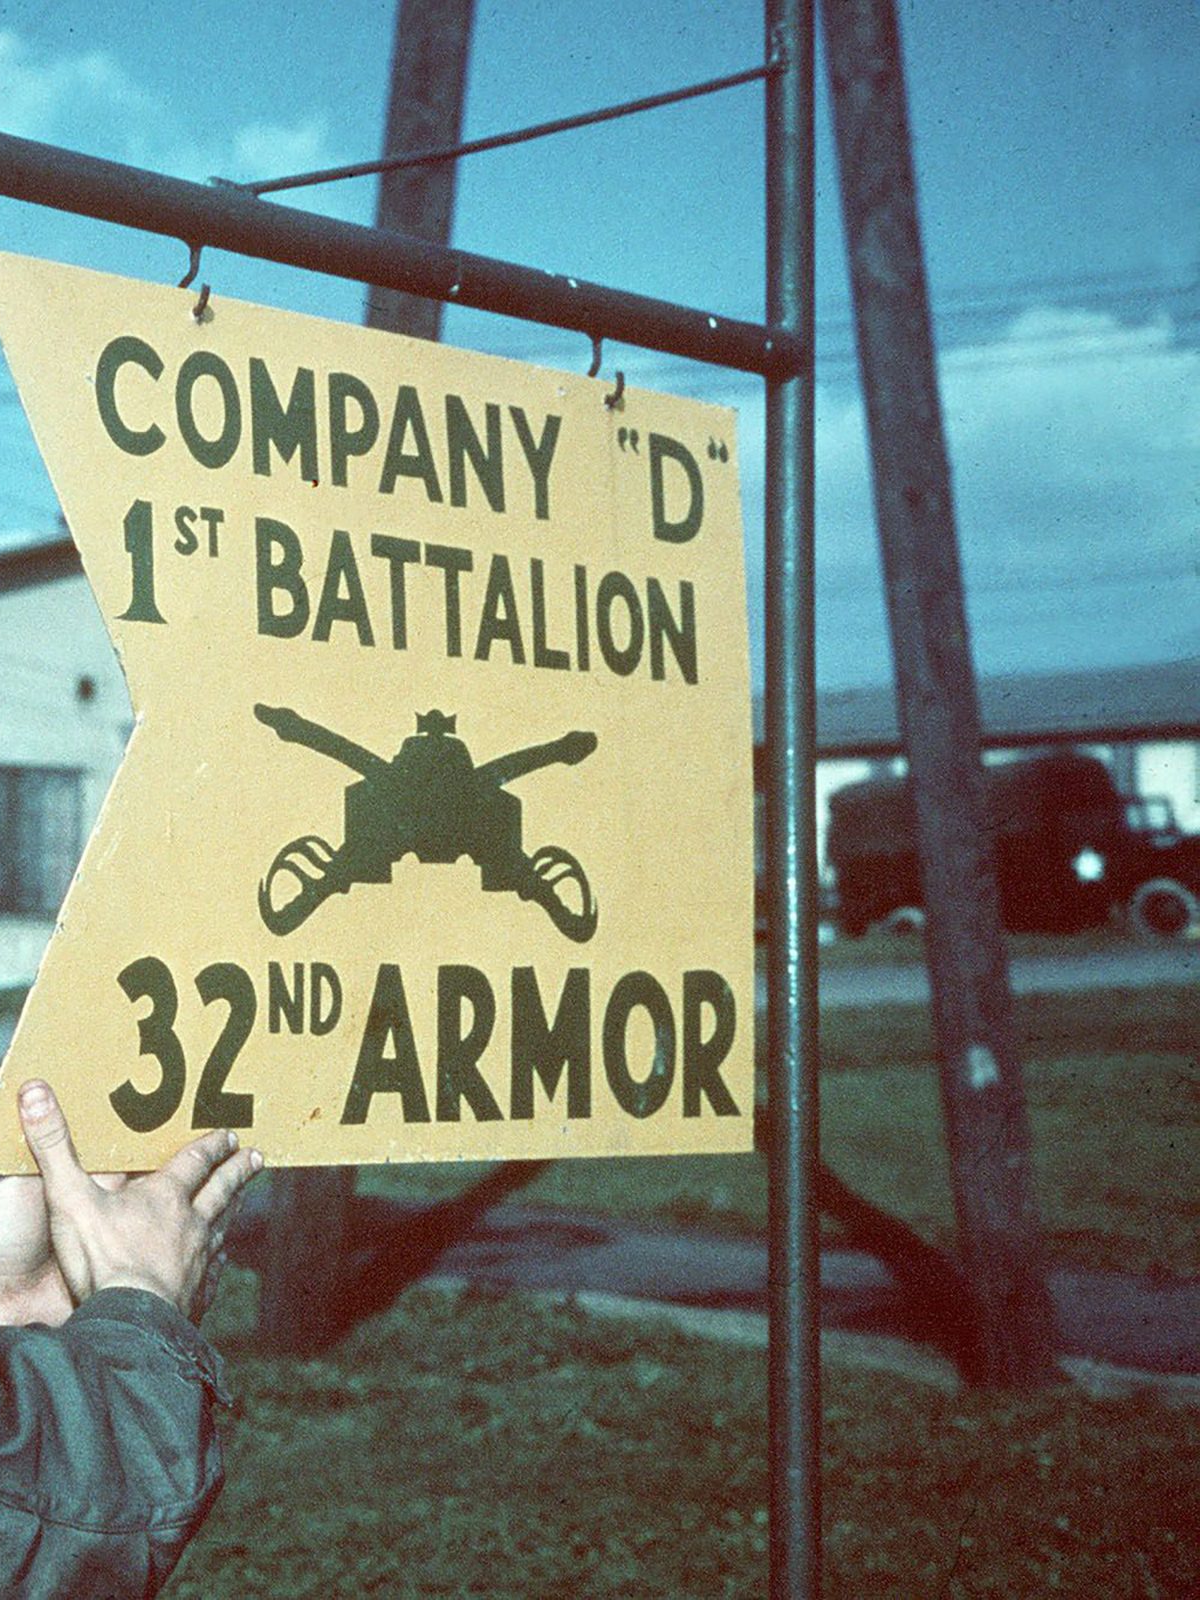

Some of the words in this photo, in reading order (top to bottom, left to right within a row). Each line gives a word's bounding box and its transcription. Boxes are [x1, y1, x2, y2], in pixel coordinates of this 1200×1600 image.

[95, 335, 562, 520] COMPANY
[115, 498, 225, 624] 1ST
[255, 517, 699, 686] BATTALION
[109, 956, 344, 1133] 32ND
[339, 963, 742, 1125] ARMOR
